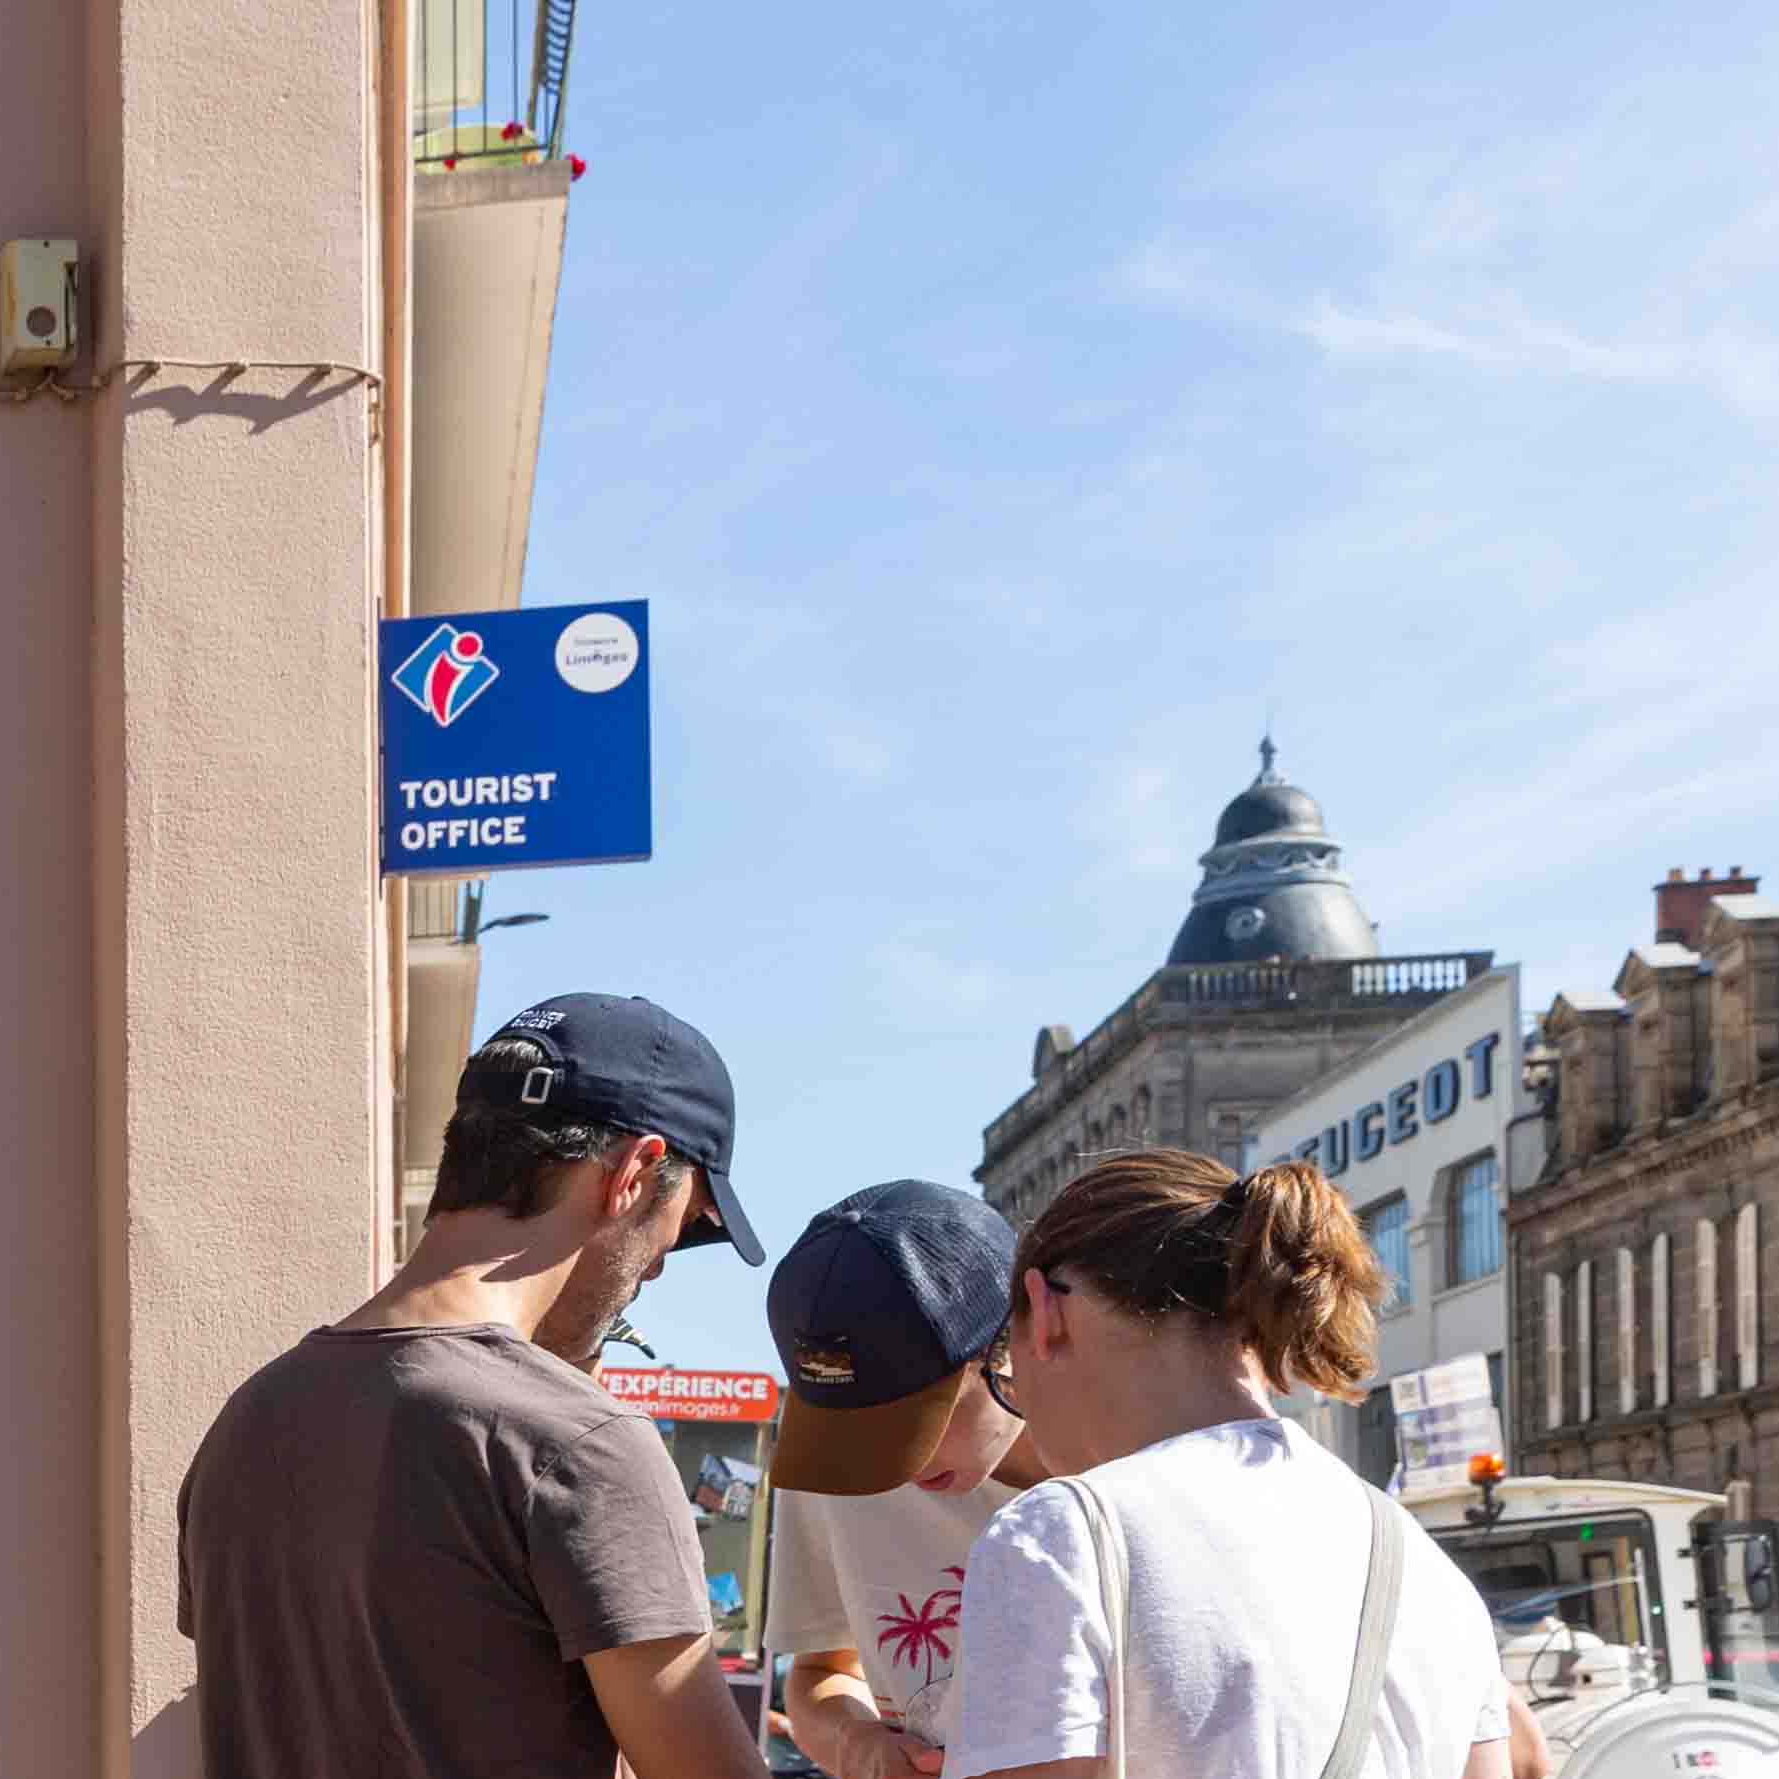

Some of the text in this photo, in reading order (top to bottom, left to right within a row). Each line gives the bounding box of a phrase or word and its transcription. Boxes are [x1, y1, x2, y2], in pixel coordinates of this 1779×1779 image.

[399, 772, 558, 810] TOURIST
[400, 815, 527, 851] OFFICE
[1271, 1030, 1501, 1180] EUGEOT
[602, 1371, 770, 1400] 'EXPÉRIENCE
